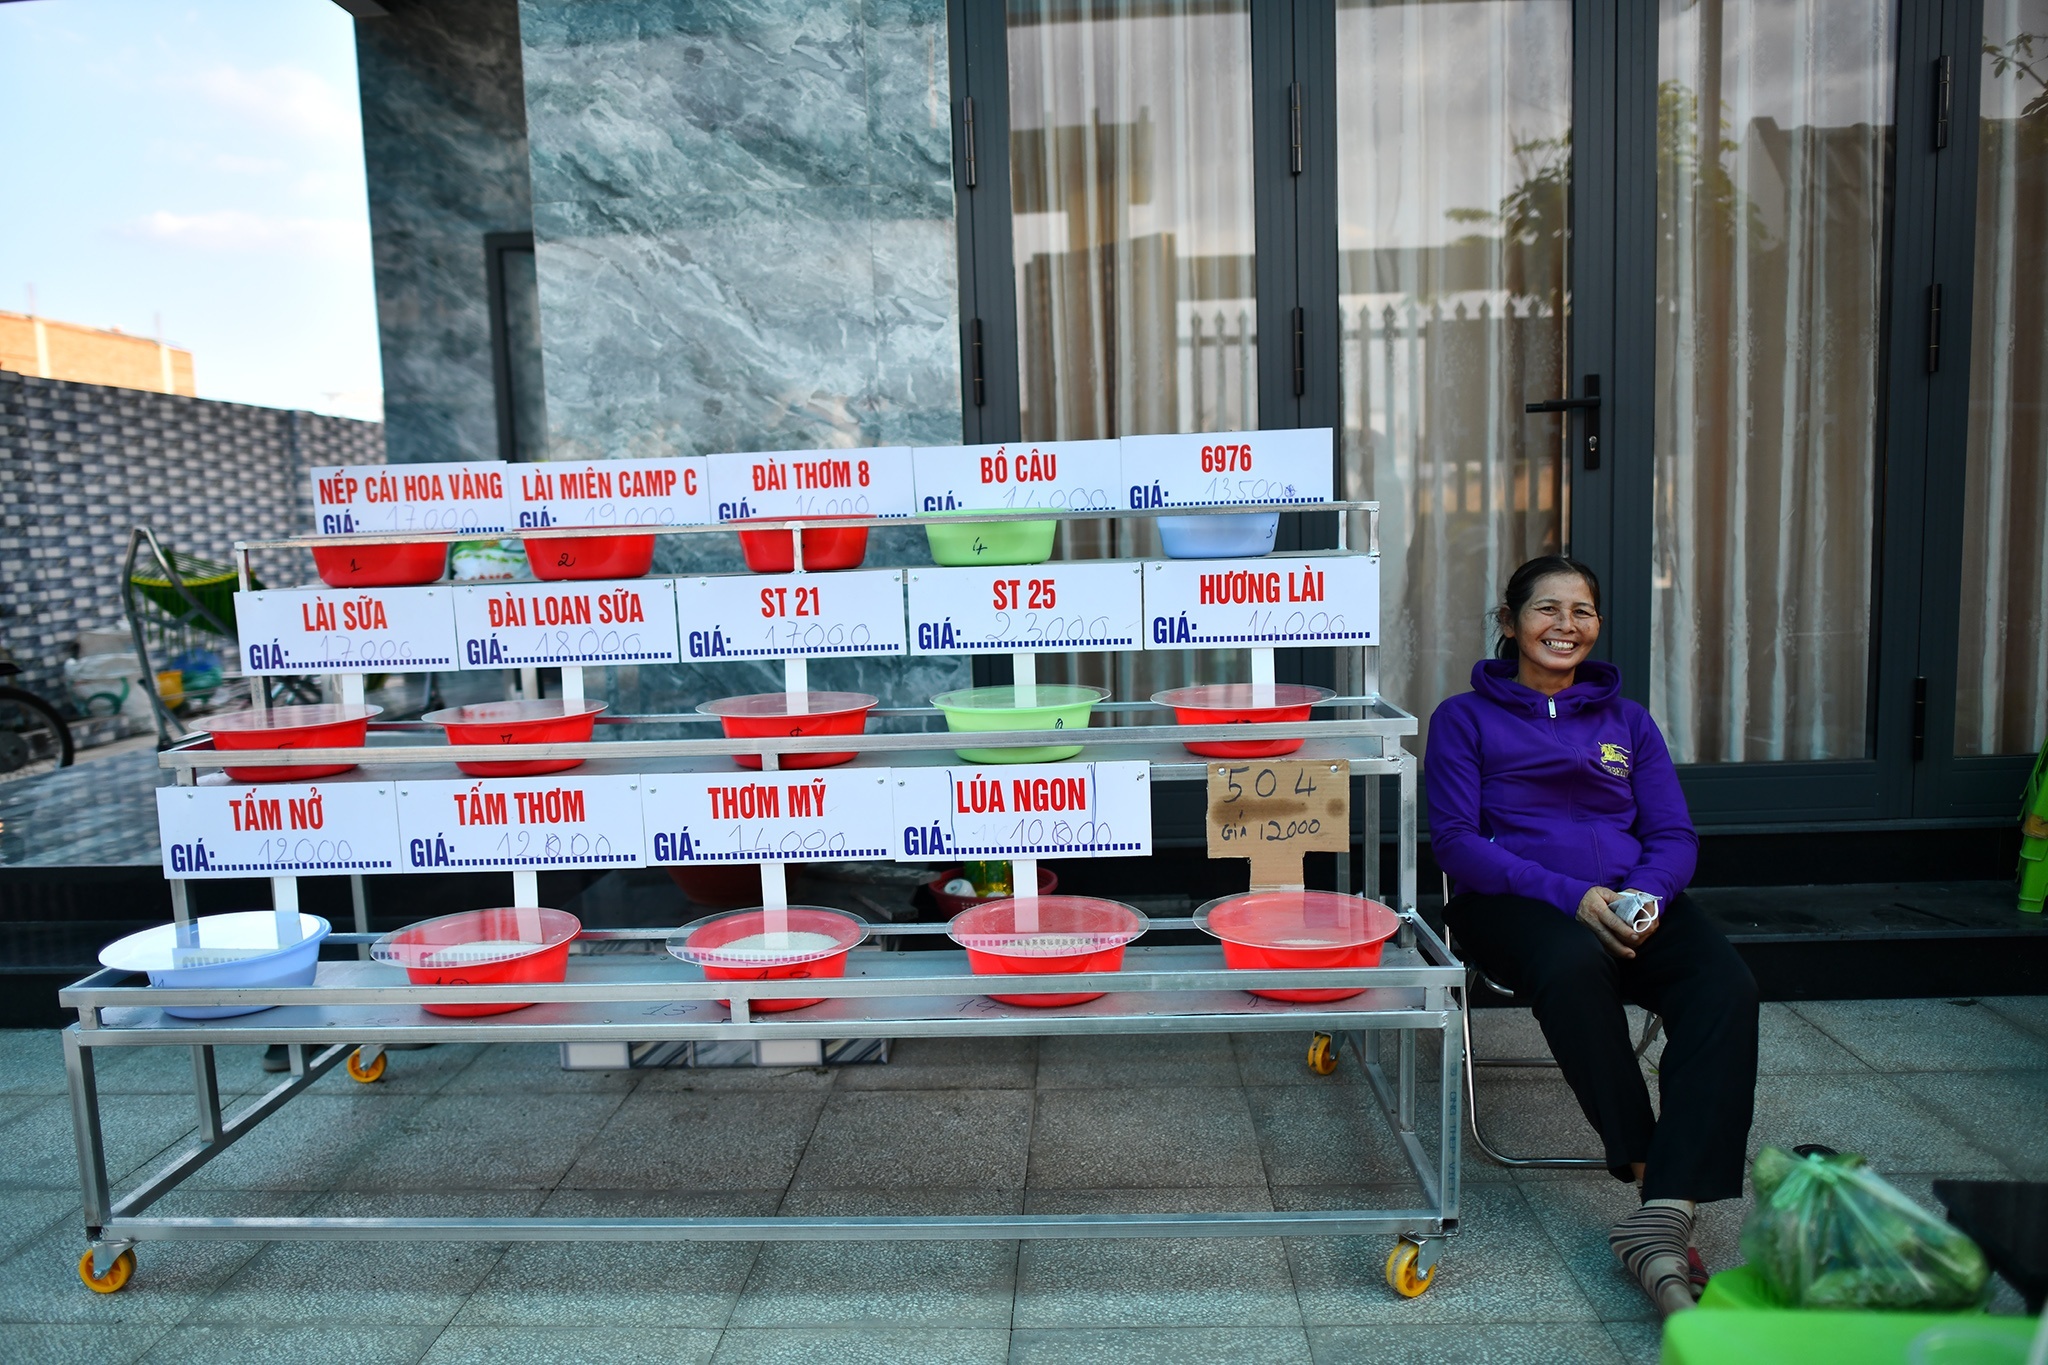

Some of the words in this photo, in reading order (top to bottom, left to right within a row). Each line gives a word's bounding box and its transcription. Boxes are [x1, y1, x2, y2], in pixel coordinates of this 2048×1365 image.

[752, 458, 787, 492] ĐÀI
[792, 458, 852, 490] THƠM
[857, 460, 871, 487] 8
[980, 446, 1008, 484] BỒ
[1015, 448, 1057, 483] CÂU
[1201, 444, 1252, 473] 6976
[319, 469, 358, 505] NẾP
[365, 470, 399, 503] CÁI
[403, 474, 445, 502] HOA
[448, 467, 503, 500] VÀNG
[521, 468, 554, 502] LÀI
[559, 466, 613, 500] MIÊN
[618, 469, 677, 499] CAMP
[683, 468, 697, 496] C
[1129, 479, 1169, 510] GIÁ:
[557, 552, 576, 567] 2
[972, 536, 988, 555] 4
[760, 587, 787, 619] ST
[795, 587, 820, 617] 21
[993, 579, 1021, 611] ST
[1028, 579, 1057, 610] 25
[1199, 570, 1281, 605] HƯƠNG
[1288, 565, 1325, 603] LÀI
[302, 596, 337, 632] LÀI
[342, 594, 388, 631] SỮA
[488, 592, 527, 628] ĐÀI
[532, 595, 592, 627] LOAN
[597, 588, 644, 625] SỮA
[688, 624, 732, 658] GIÁ:
[765, 621, 871, 649] 17000
[918, 616, 962, 650] GIÁ:
[985, 611, 1110, 643] 23000
[1153, 610, 1198, 645] GIÁ:
[248, 637, 291, 671] GIÁ:
[466, 632, 509, 666] GIÁ:
[535, 627, 642, 657] 18000
[229, 787, 283, 831] TẤM
[288, 787, 324, 830] NỞ
[453, 786, 508, 826] TẤM
[513, 787, 586, 825] THƠM
[707, 783, 780, 820] THƠM
[787, 777, 827, 818] MỸ
[956, 773, 1006, 814] LÚA
[1012, 777, 1087, 813] NGON
[653, 825, 702, 862] GIÁ:
[903, 819, 952, 856] GIÁ:
[1260, 818, 1321, 841] 12000
[170, 837, 217, 873] GIÁ:
[409, 832, 456, 868] GIÁ:
